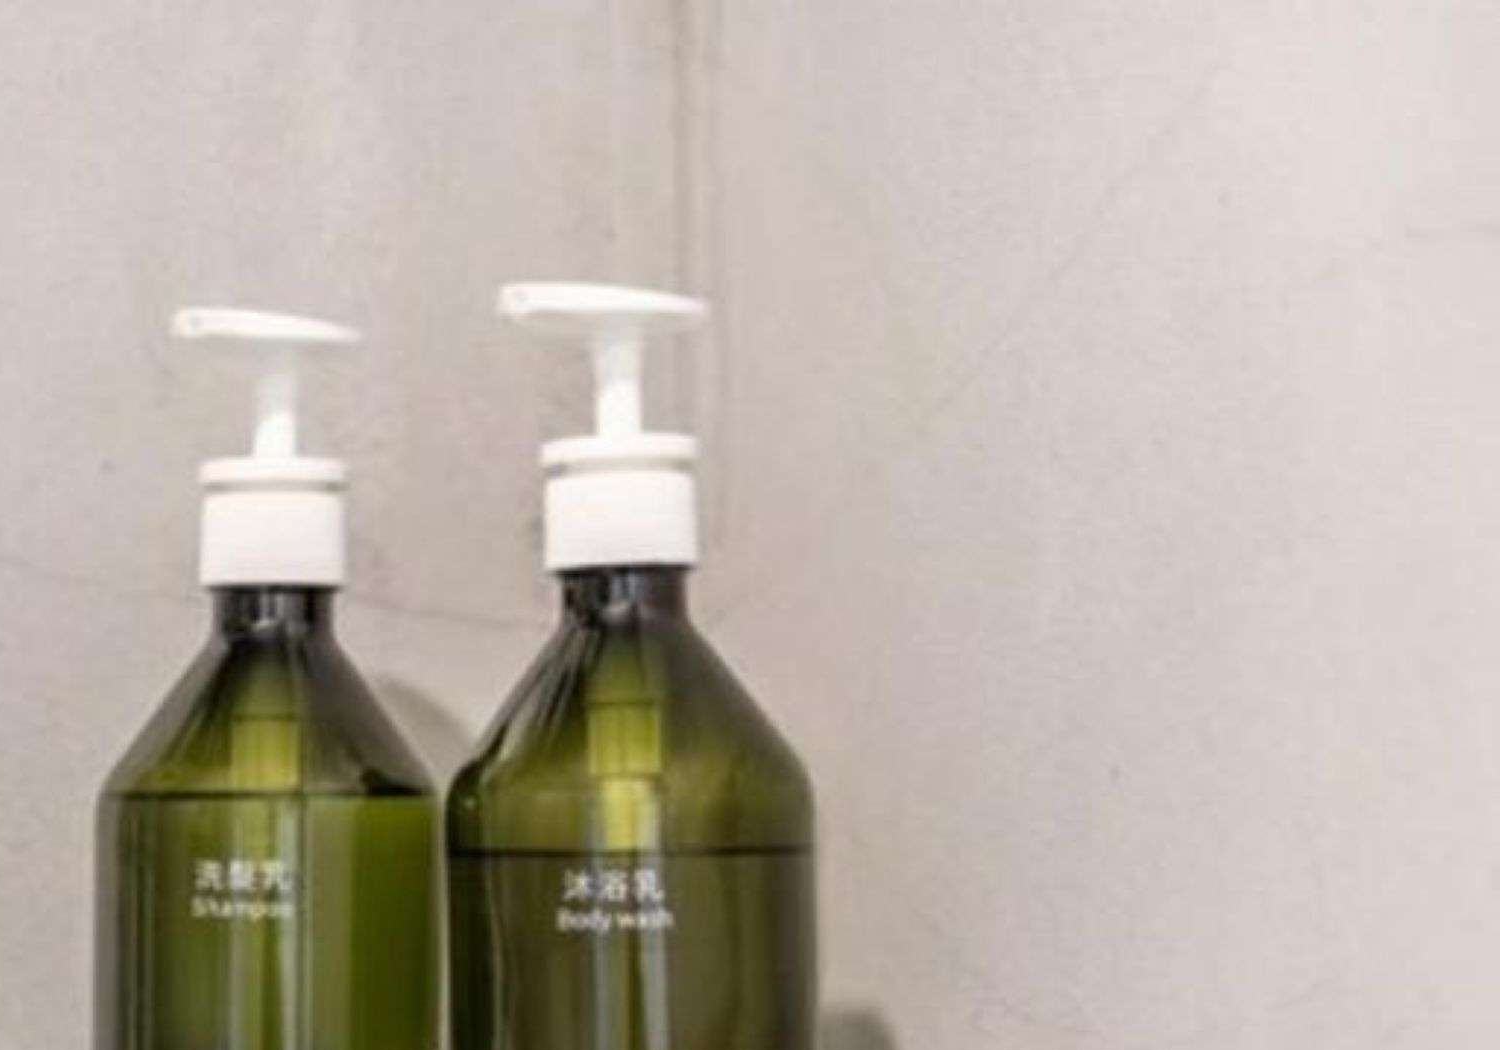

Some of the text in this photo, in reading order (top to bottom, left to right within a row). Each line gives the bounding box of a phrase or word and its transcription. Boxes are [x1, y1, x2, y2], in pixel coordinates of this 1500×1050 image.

[563, 867, 664, 901] 沐浴乳
[191, 897, 294, 922] Shampoo
[556, 906, 674, 934] Body wash
